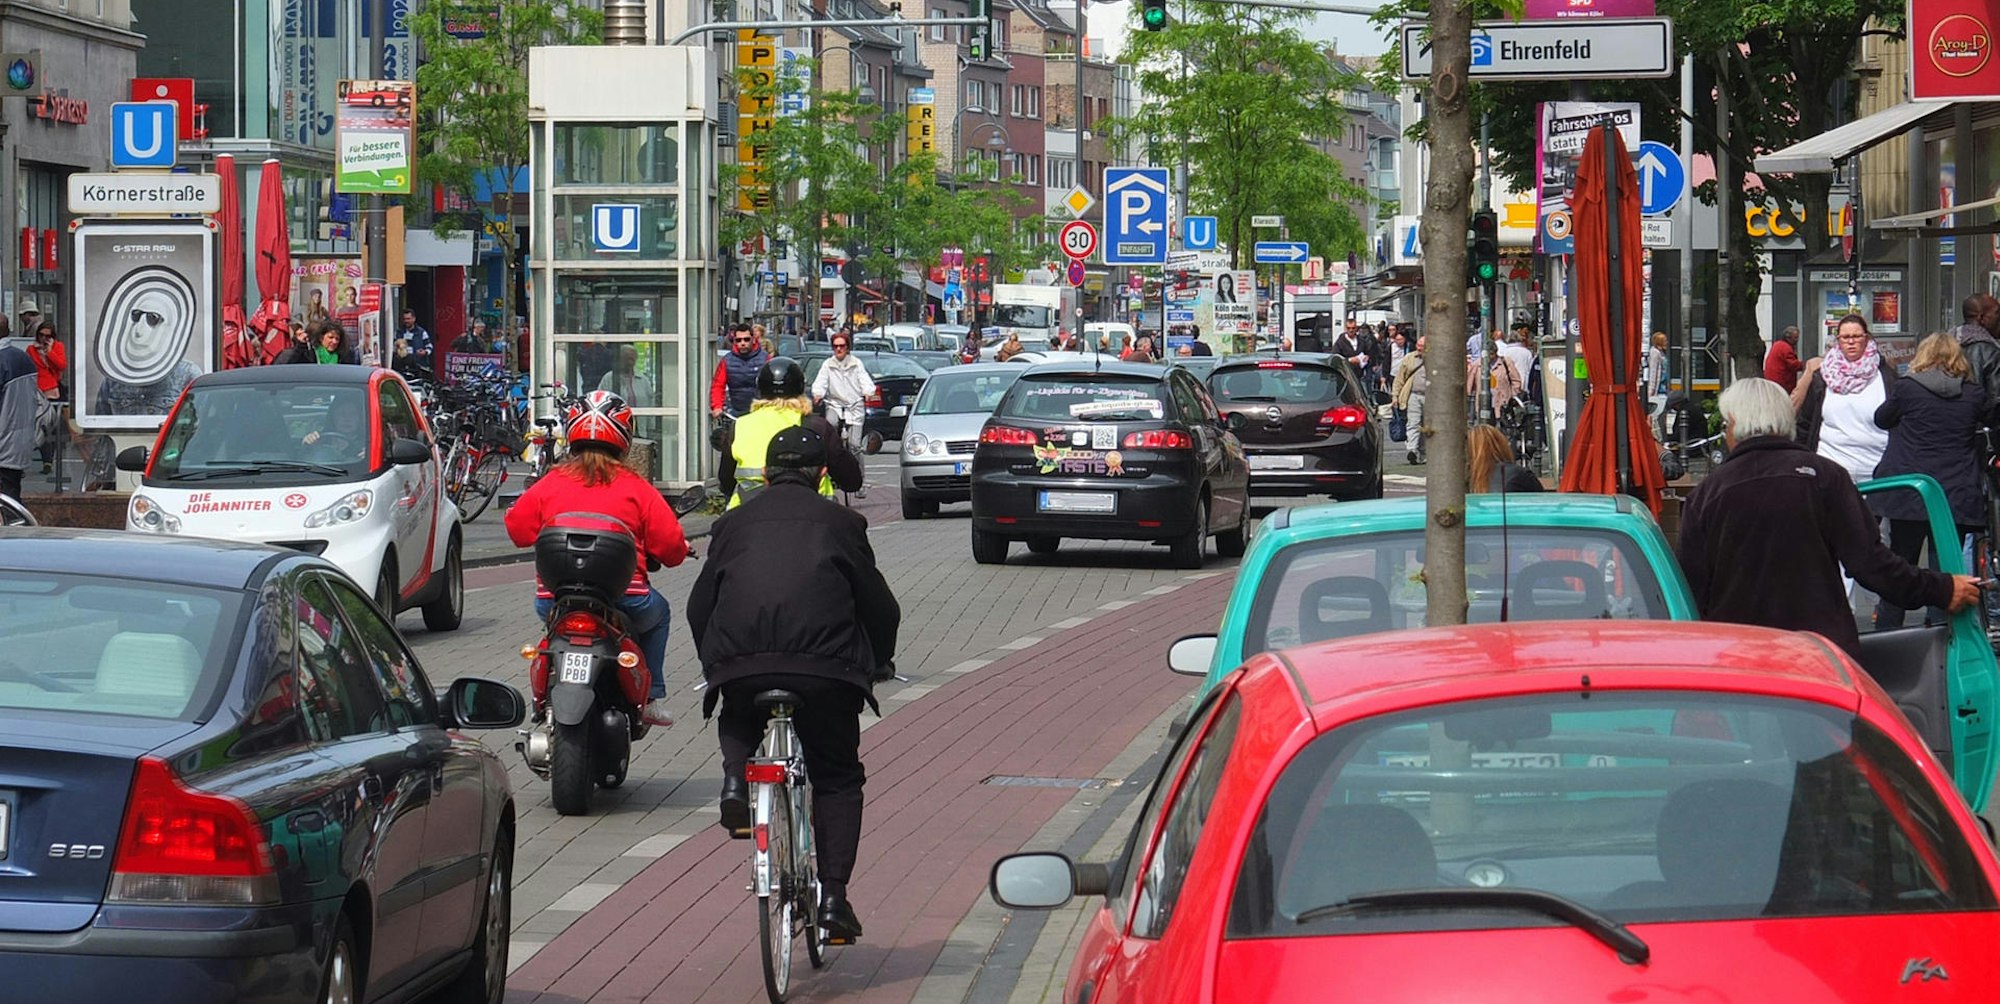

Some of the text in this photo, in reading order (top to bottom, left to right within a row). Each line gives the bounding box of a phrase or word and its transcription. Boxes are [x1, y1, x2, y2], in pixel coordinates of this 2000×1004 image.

[1501, 39, 1591, 60] Ehrenfeld
[1933, 34, 1987, 52] Aroy-D
[752, 28, 771, 207] POTHEE
[124, 112, 162, 158] U
[363, 141, 400, 151] bessere
[1553, 137, 1577, 149] statt
[344, 151, 404, 164] Verbindungen.
[83, 185, 205, 201] Körnerstraße
[1121, 190, 1151, 234] P
[598, 208, 635, 247] U
[1190, 221, 1210, 245] U
[1647, 224, 1660, 232] Rot
[1068, 232, 1089, 248] 30
[1120, 245, 1152, 254] EINFAHRT
[1201, 260, 1231, 268] straße
[1306, 260, 1320, 278] T
[1072, 387, 1086, 395] für
[189, 492, 212, 503] DIE
[183, 500, 271, 513] JOHANNITER
[566, 654, 589, 667] 568
[565, 668, 587, 681] PBB
